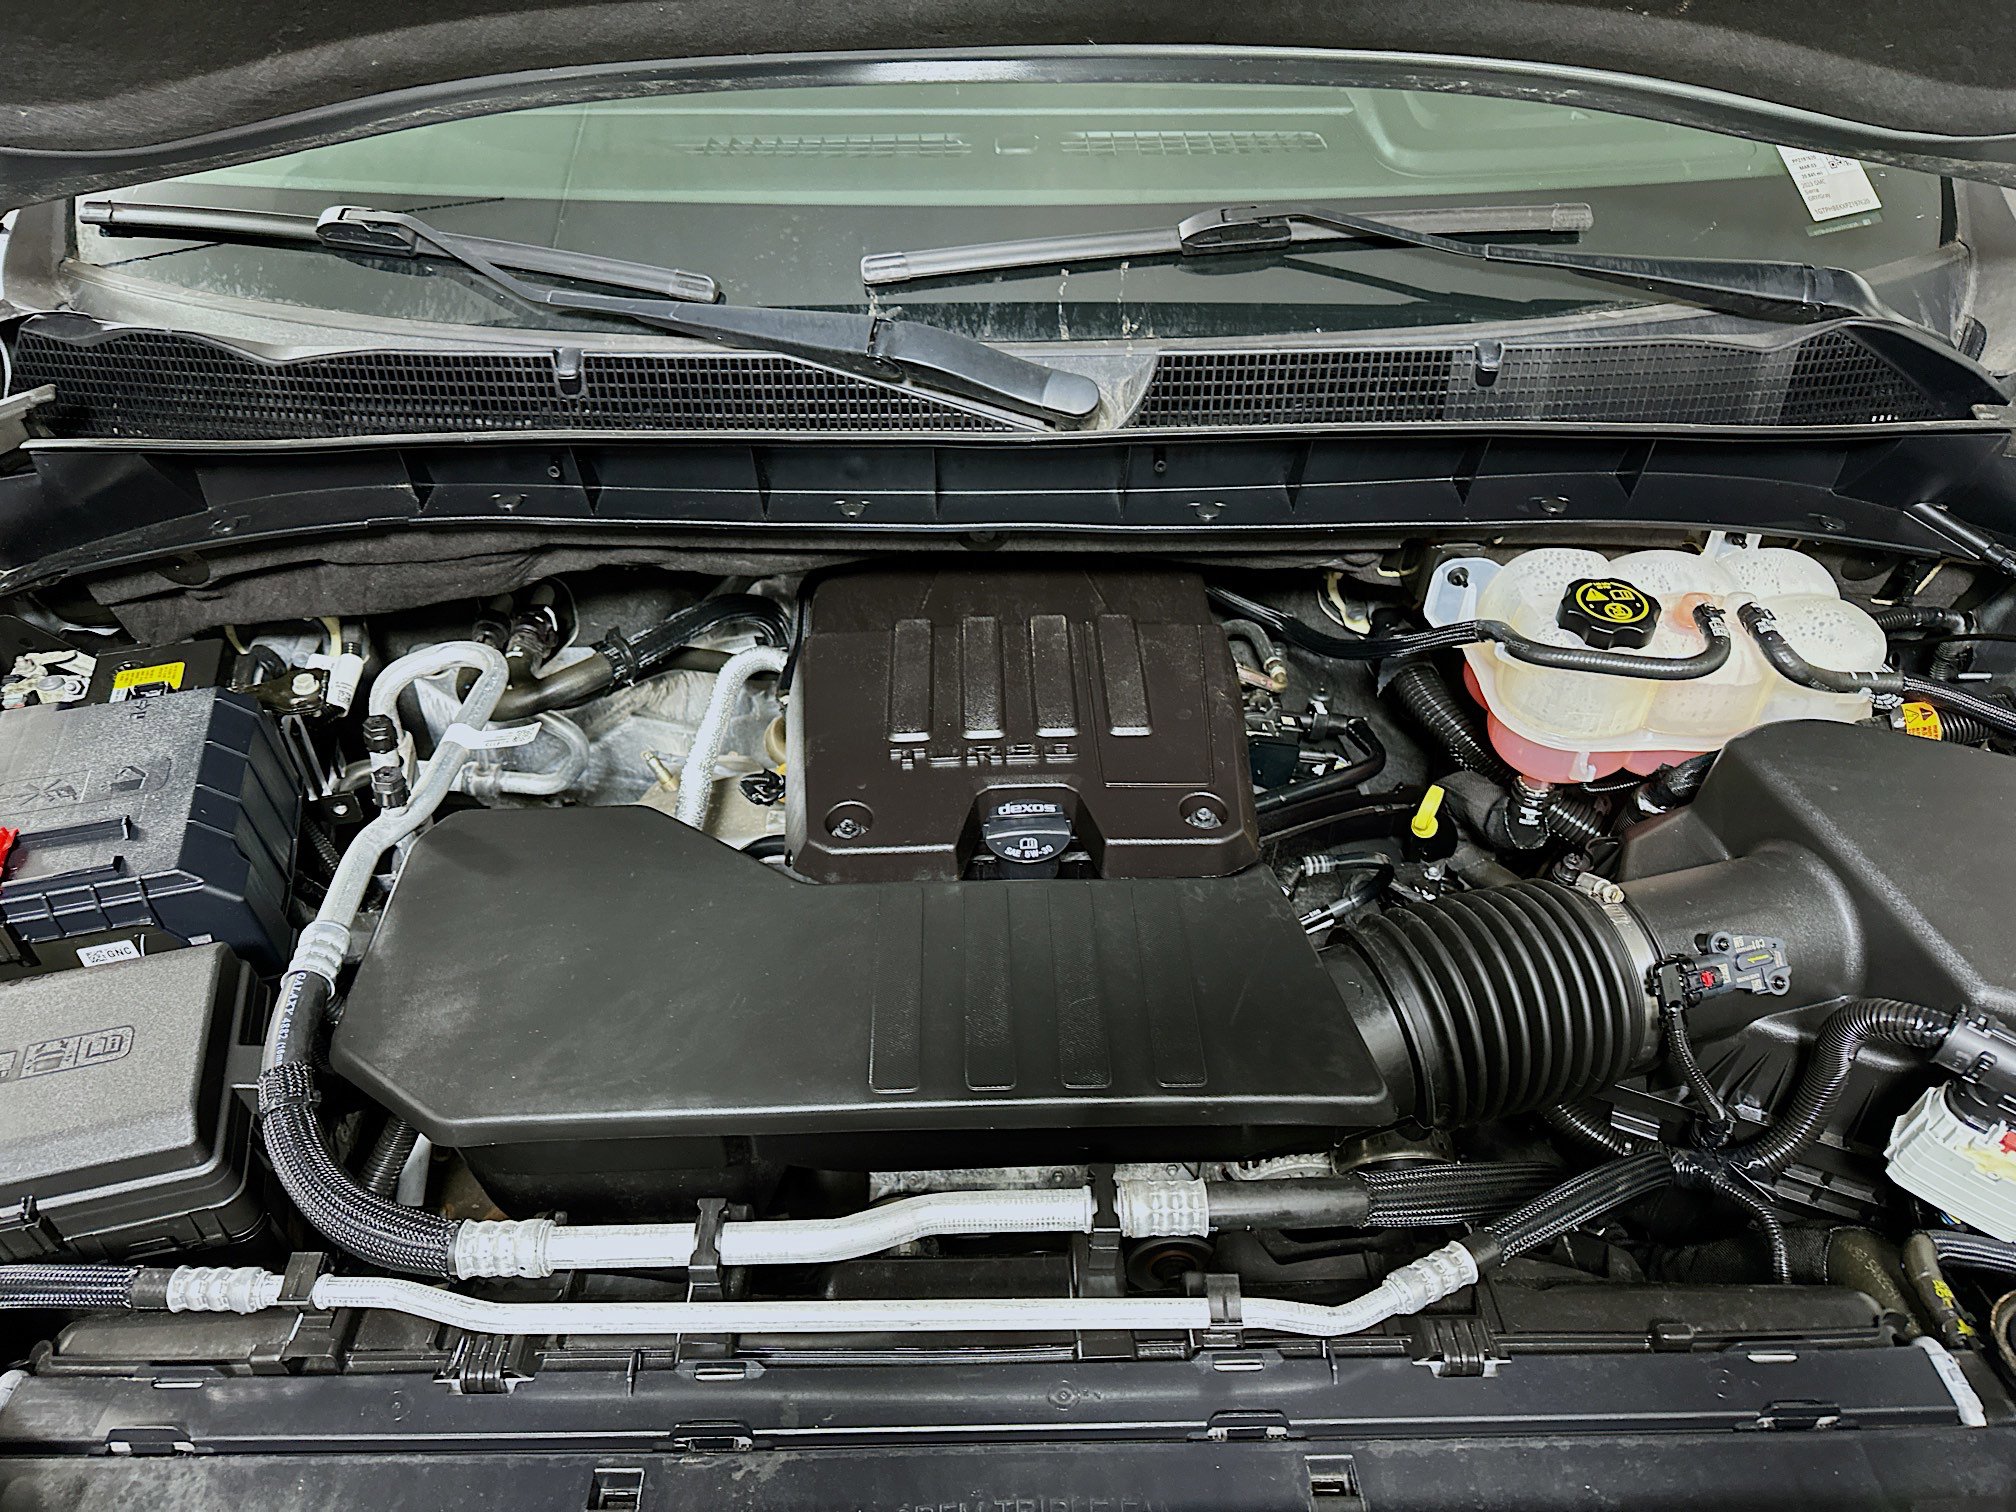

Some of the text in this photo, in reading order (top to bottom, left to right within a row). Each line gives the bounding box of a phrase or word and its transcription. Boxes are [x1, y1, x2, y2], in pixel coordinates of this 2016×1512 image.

[997, 802, 1058, 815] dexos
[1004, 845, 1054, 859] SAE 5W-30
[285, 972, 307, 1016] GALAXY
[278, 1017, 292, 1040] 4882
